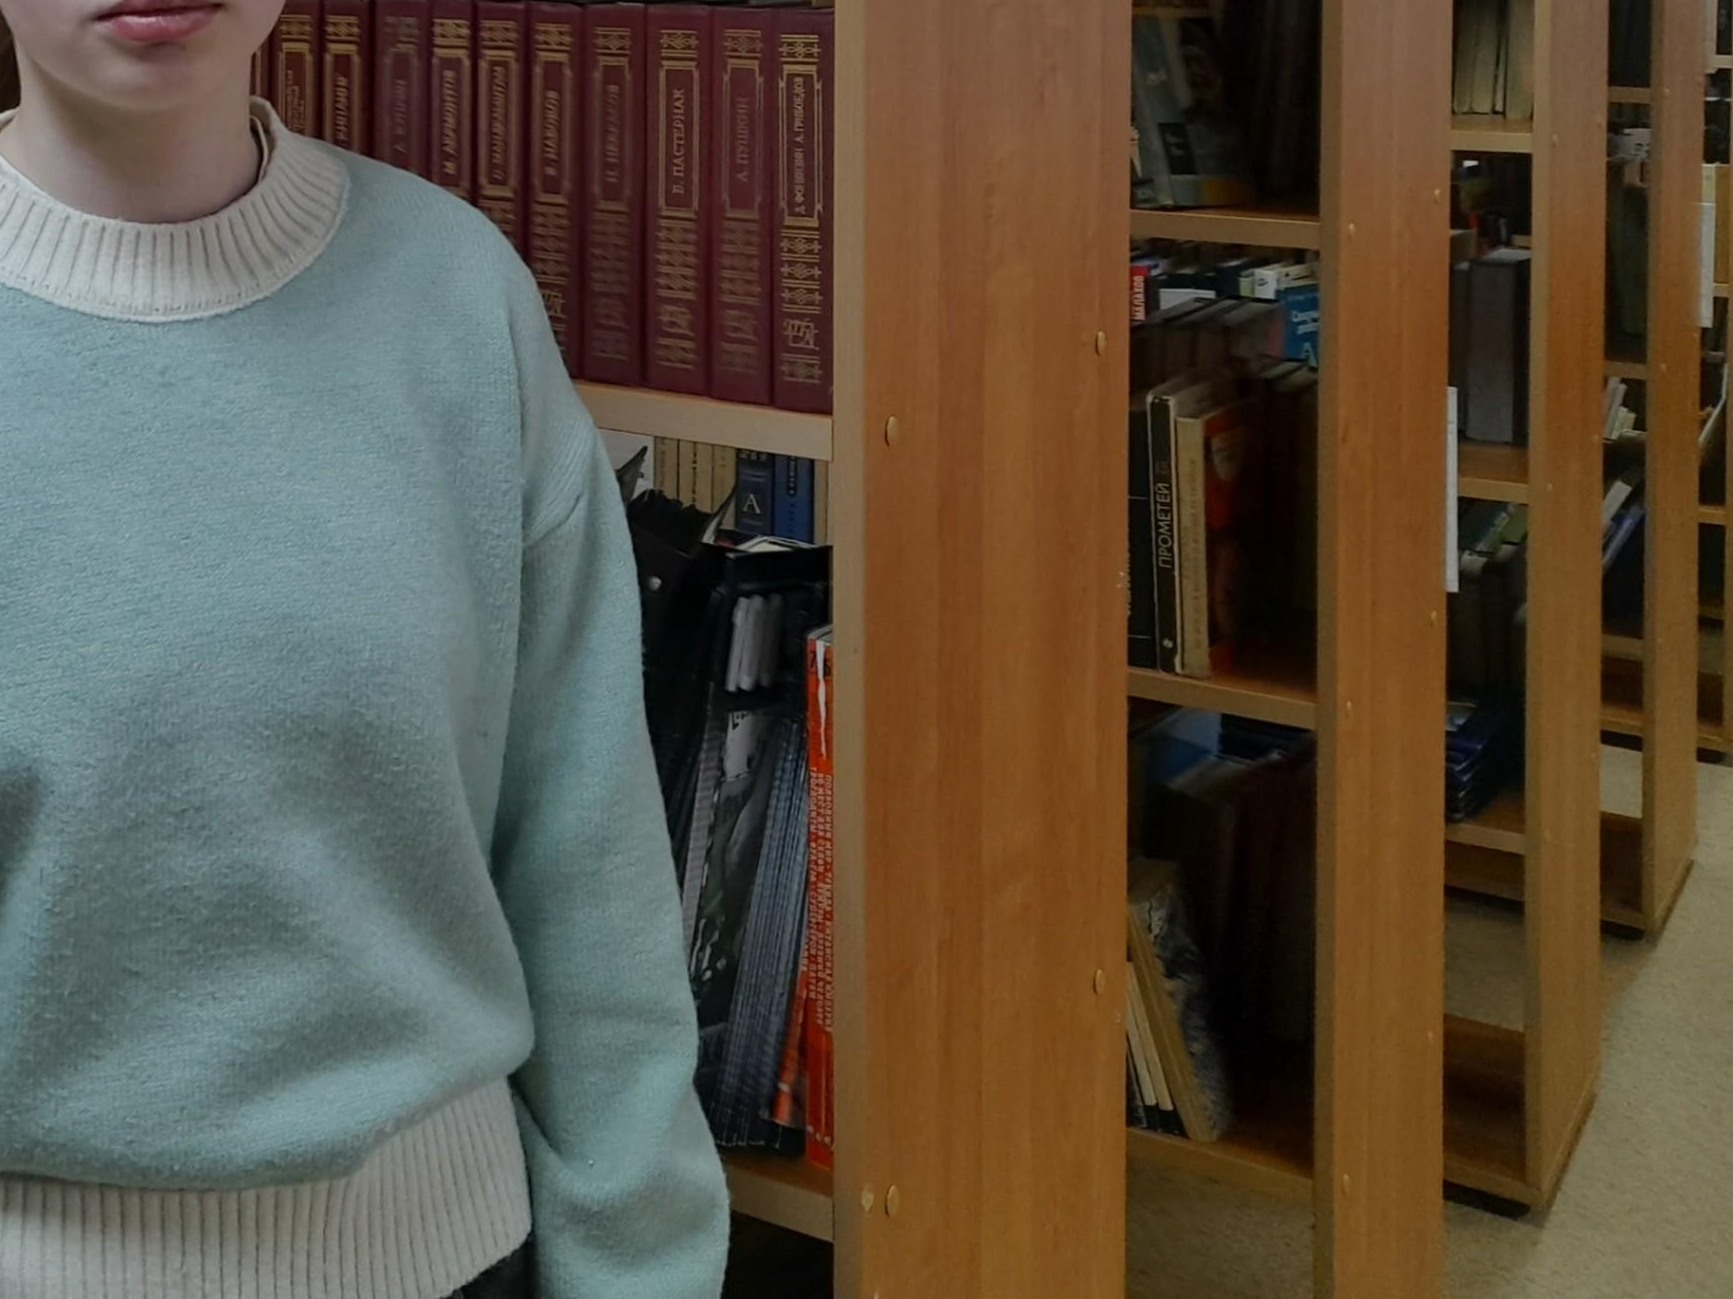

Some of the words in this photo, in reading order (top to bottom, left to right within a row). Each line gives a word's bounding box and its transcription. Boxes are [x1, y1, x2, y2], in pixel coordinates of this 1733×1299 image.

[671, 87, 685, 177] ПАСТЕРНАК
[734, 96, 749, 165] ПУШКИН
[1155, 482, 1173, 569] ПРОМЕТЕЙ
